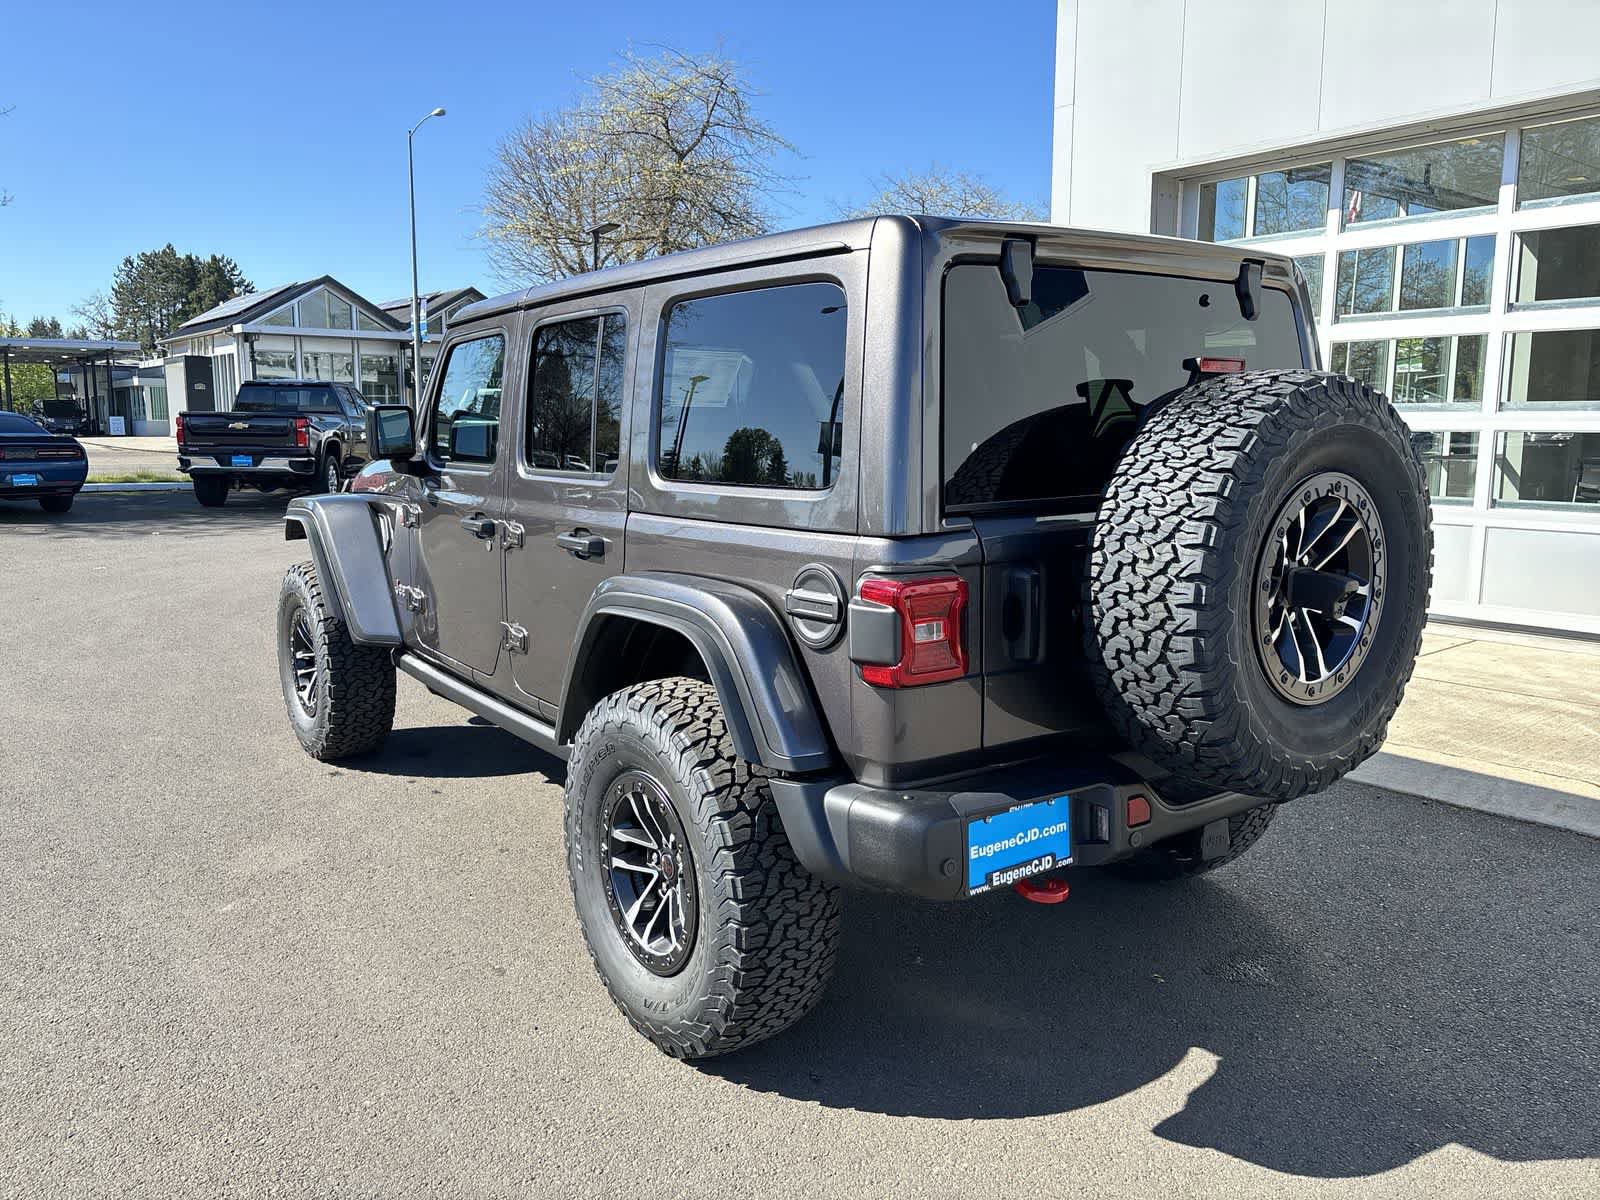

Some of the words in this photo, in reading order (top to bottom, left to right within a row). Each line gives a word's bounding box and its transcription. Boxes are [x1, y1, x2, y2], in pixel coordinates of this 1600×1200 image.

[970, 822, 1066, 859] EugeneCJD.com
[970, 884, 991, 896] www.
[993, 856, 1052, 886] EugeneCJD
